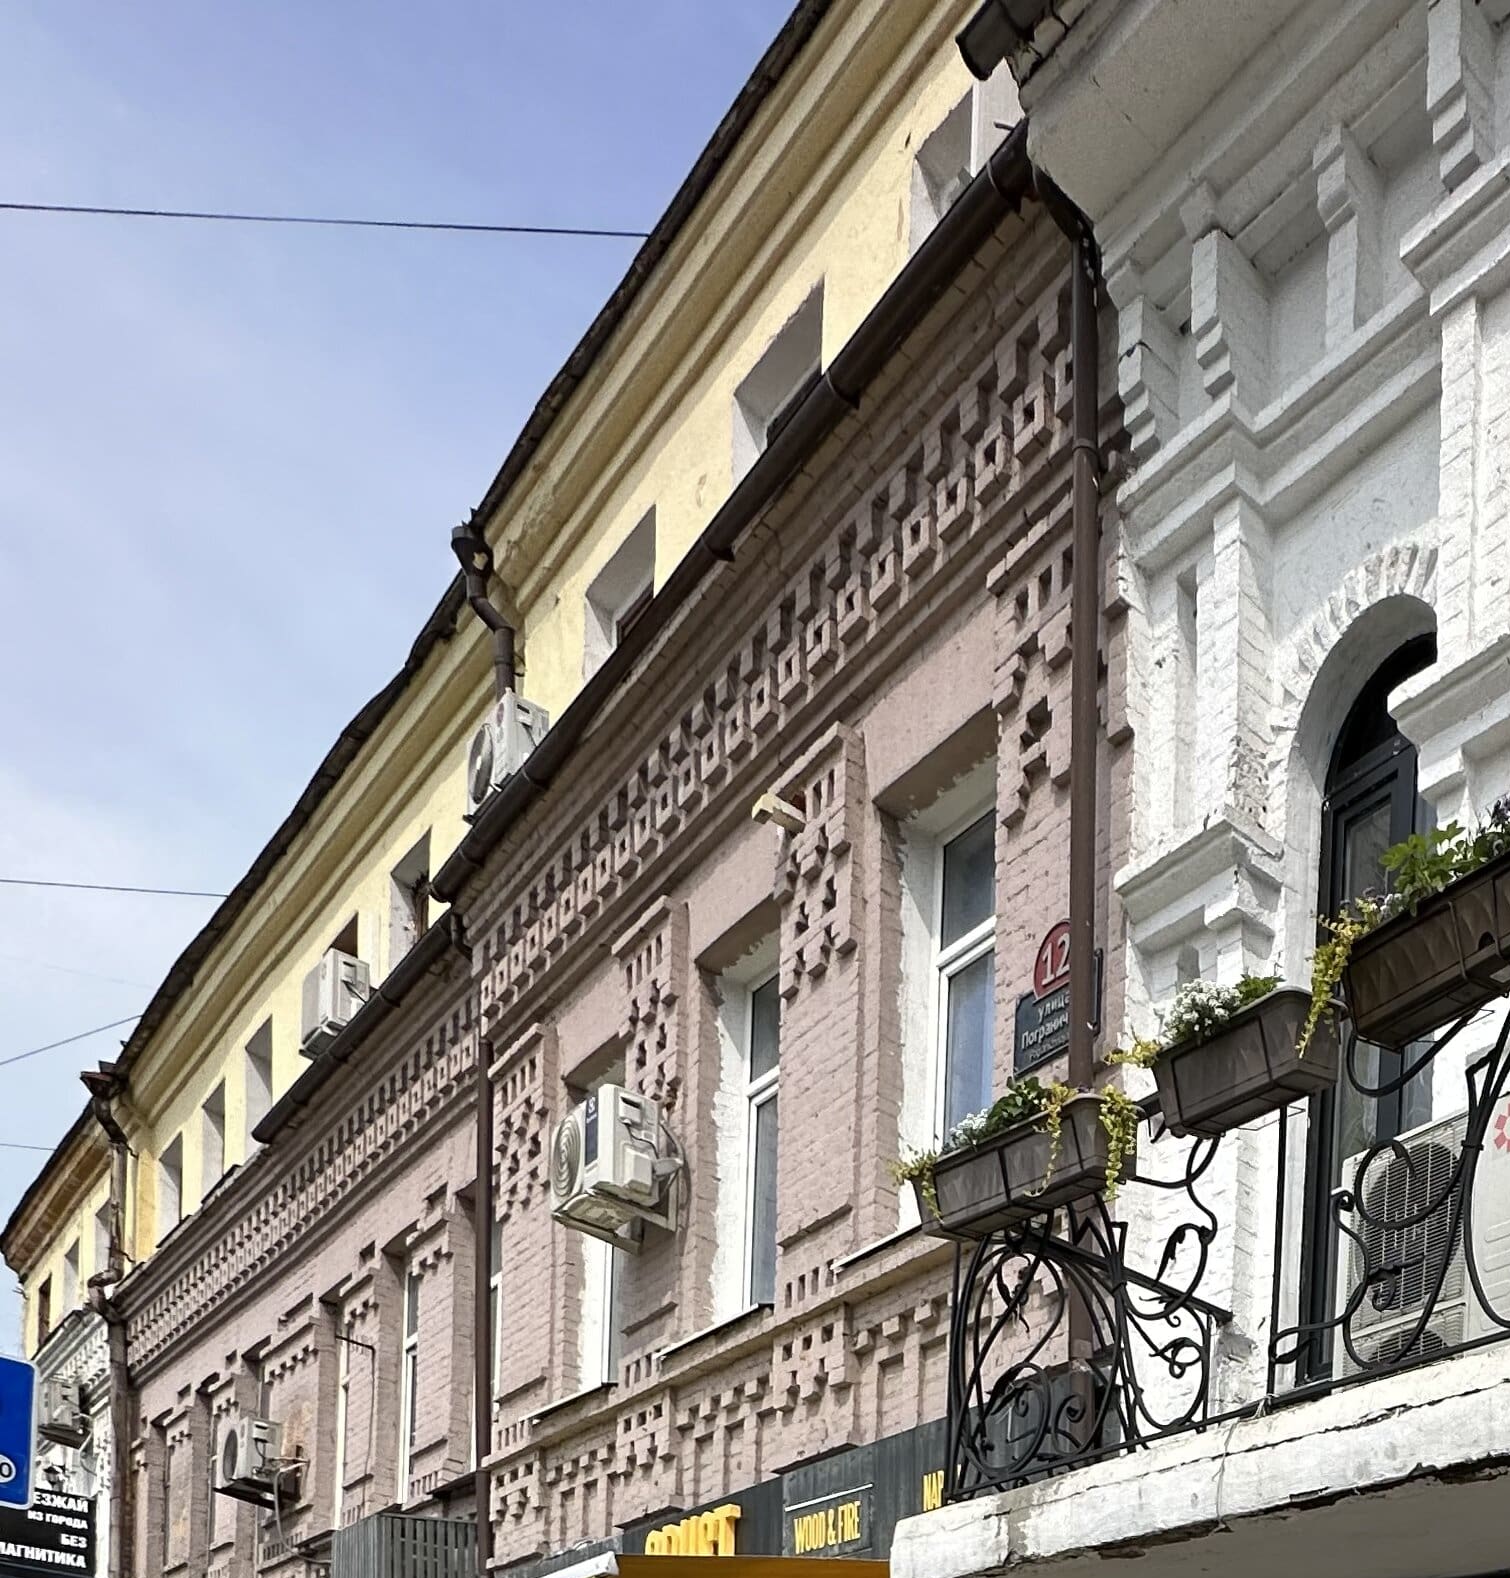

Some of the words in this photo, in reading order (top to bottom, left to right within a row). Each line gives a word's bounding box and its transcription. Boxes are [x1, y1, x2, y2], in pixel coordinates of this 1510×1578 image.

[1041, 932, 1070, 987] 12
[1021, 1011, 1069, 1049] Погранич
[33, 1491, 89, 1513] ЕЗЖАЙ
[27, 1510, 43, 1522] ИЗ
[45, 1513, 88, 1529] ГОРОДА
[794, 1511, 825, 1554] WOOD
[827, 1511, 836, 1547] &
[838, 1501, 861, 1543] FIRE
[60, 1533, 87, 1548] БЕЗ
